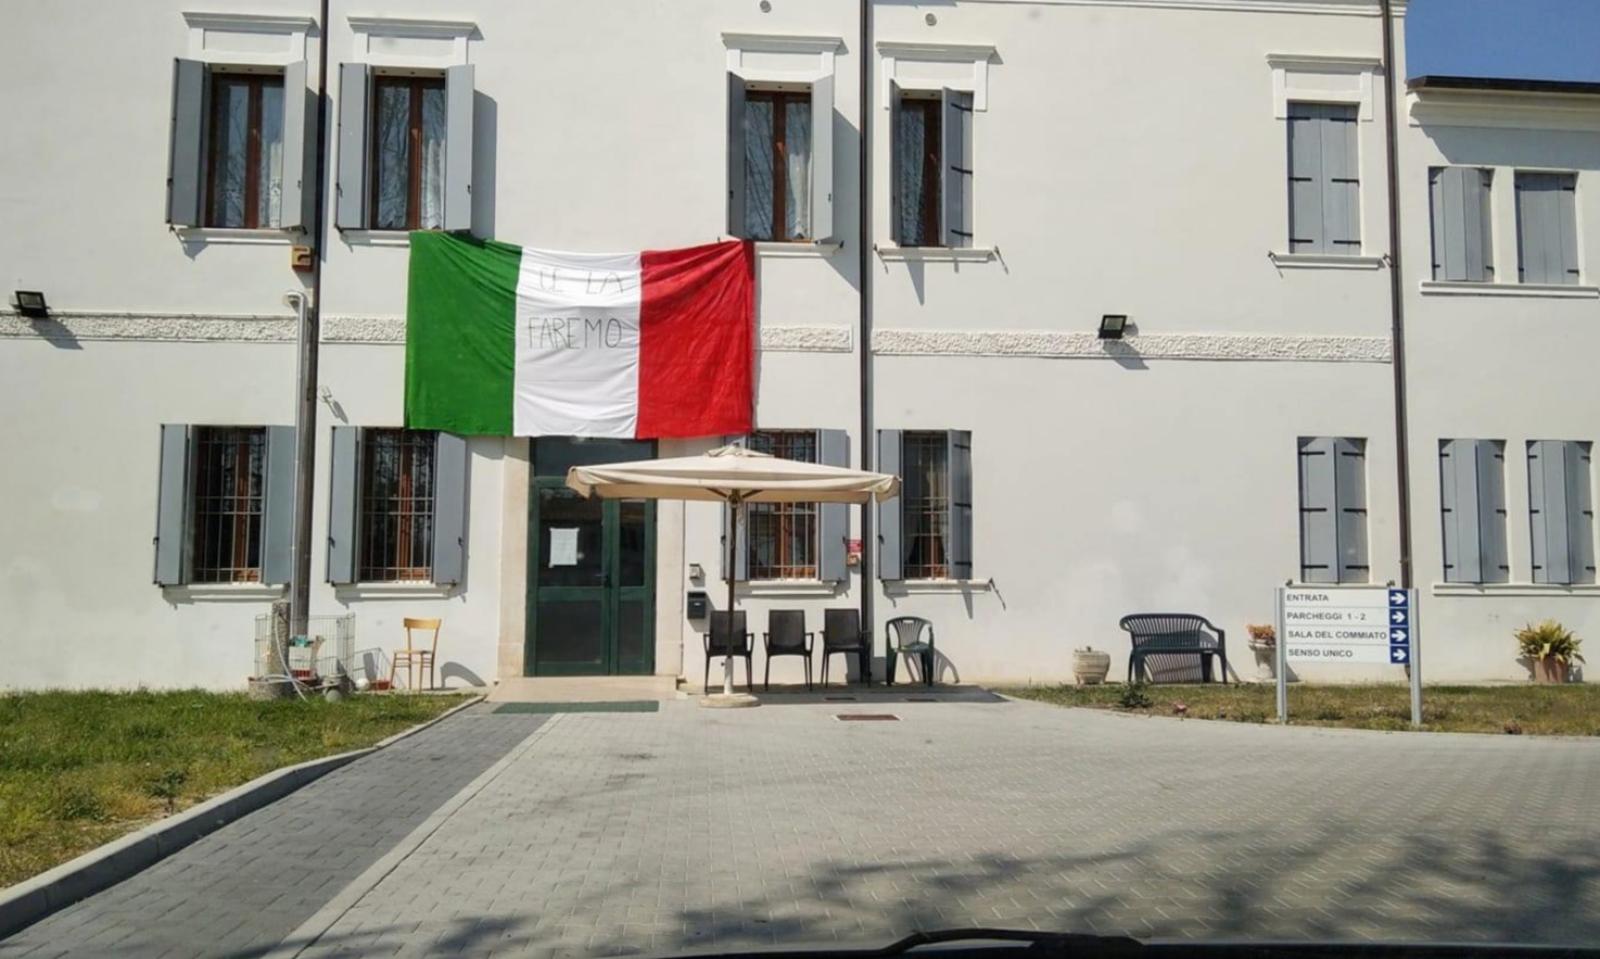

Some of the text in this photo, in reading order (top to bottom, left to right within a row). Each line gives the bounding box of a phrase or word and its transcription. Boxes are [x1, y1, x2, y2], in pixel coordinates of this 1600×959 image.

[586, 270, 624, 294] LA
[528, 317, 622, 350] FAREMO
[1286, 612, 1343, 620] PARCHEGGI
[1288, 631, 1387, 640] SALA DEL COMMIATO
[1288, 648, 1353, 658] SENSO UNICO
